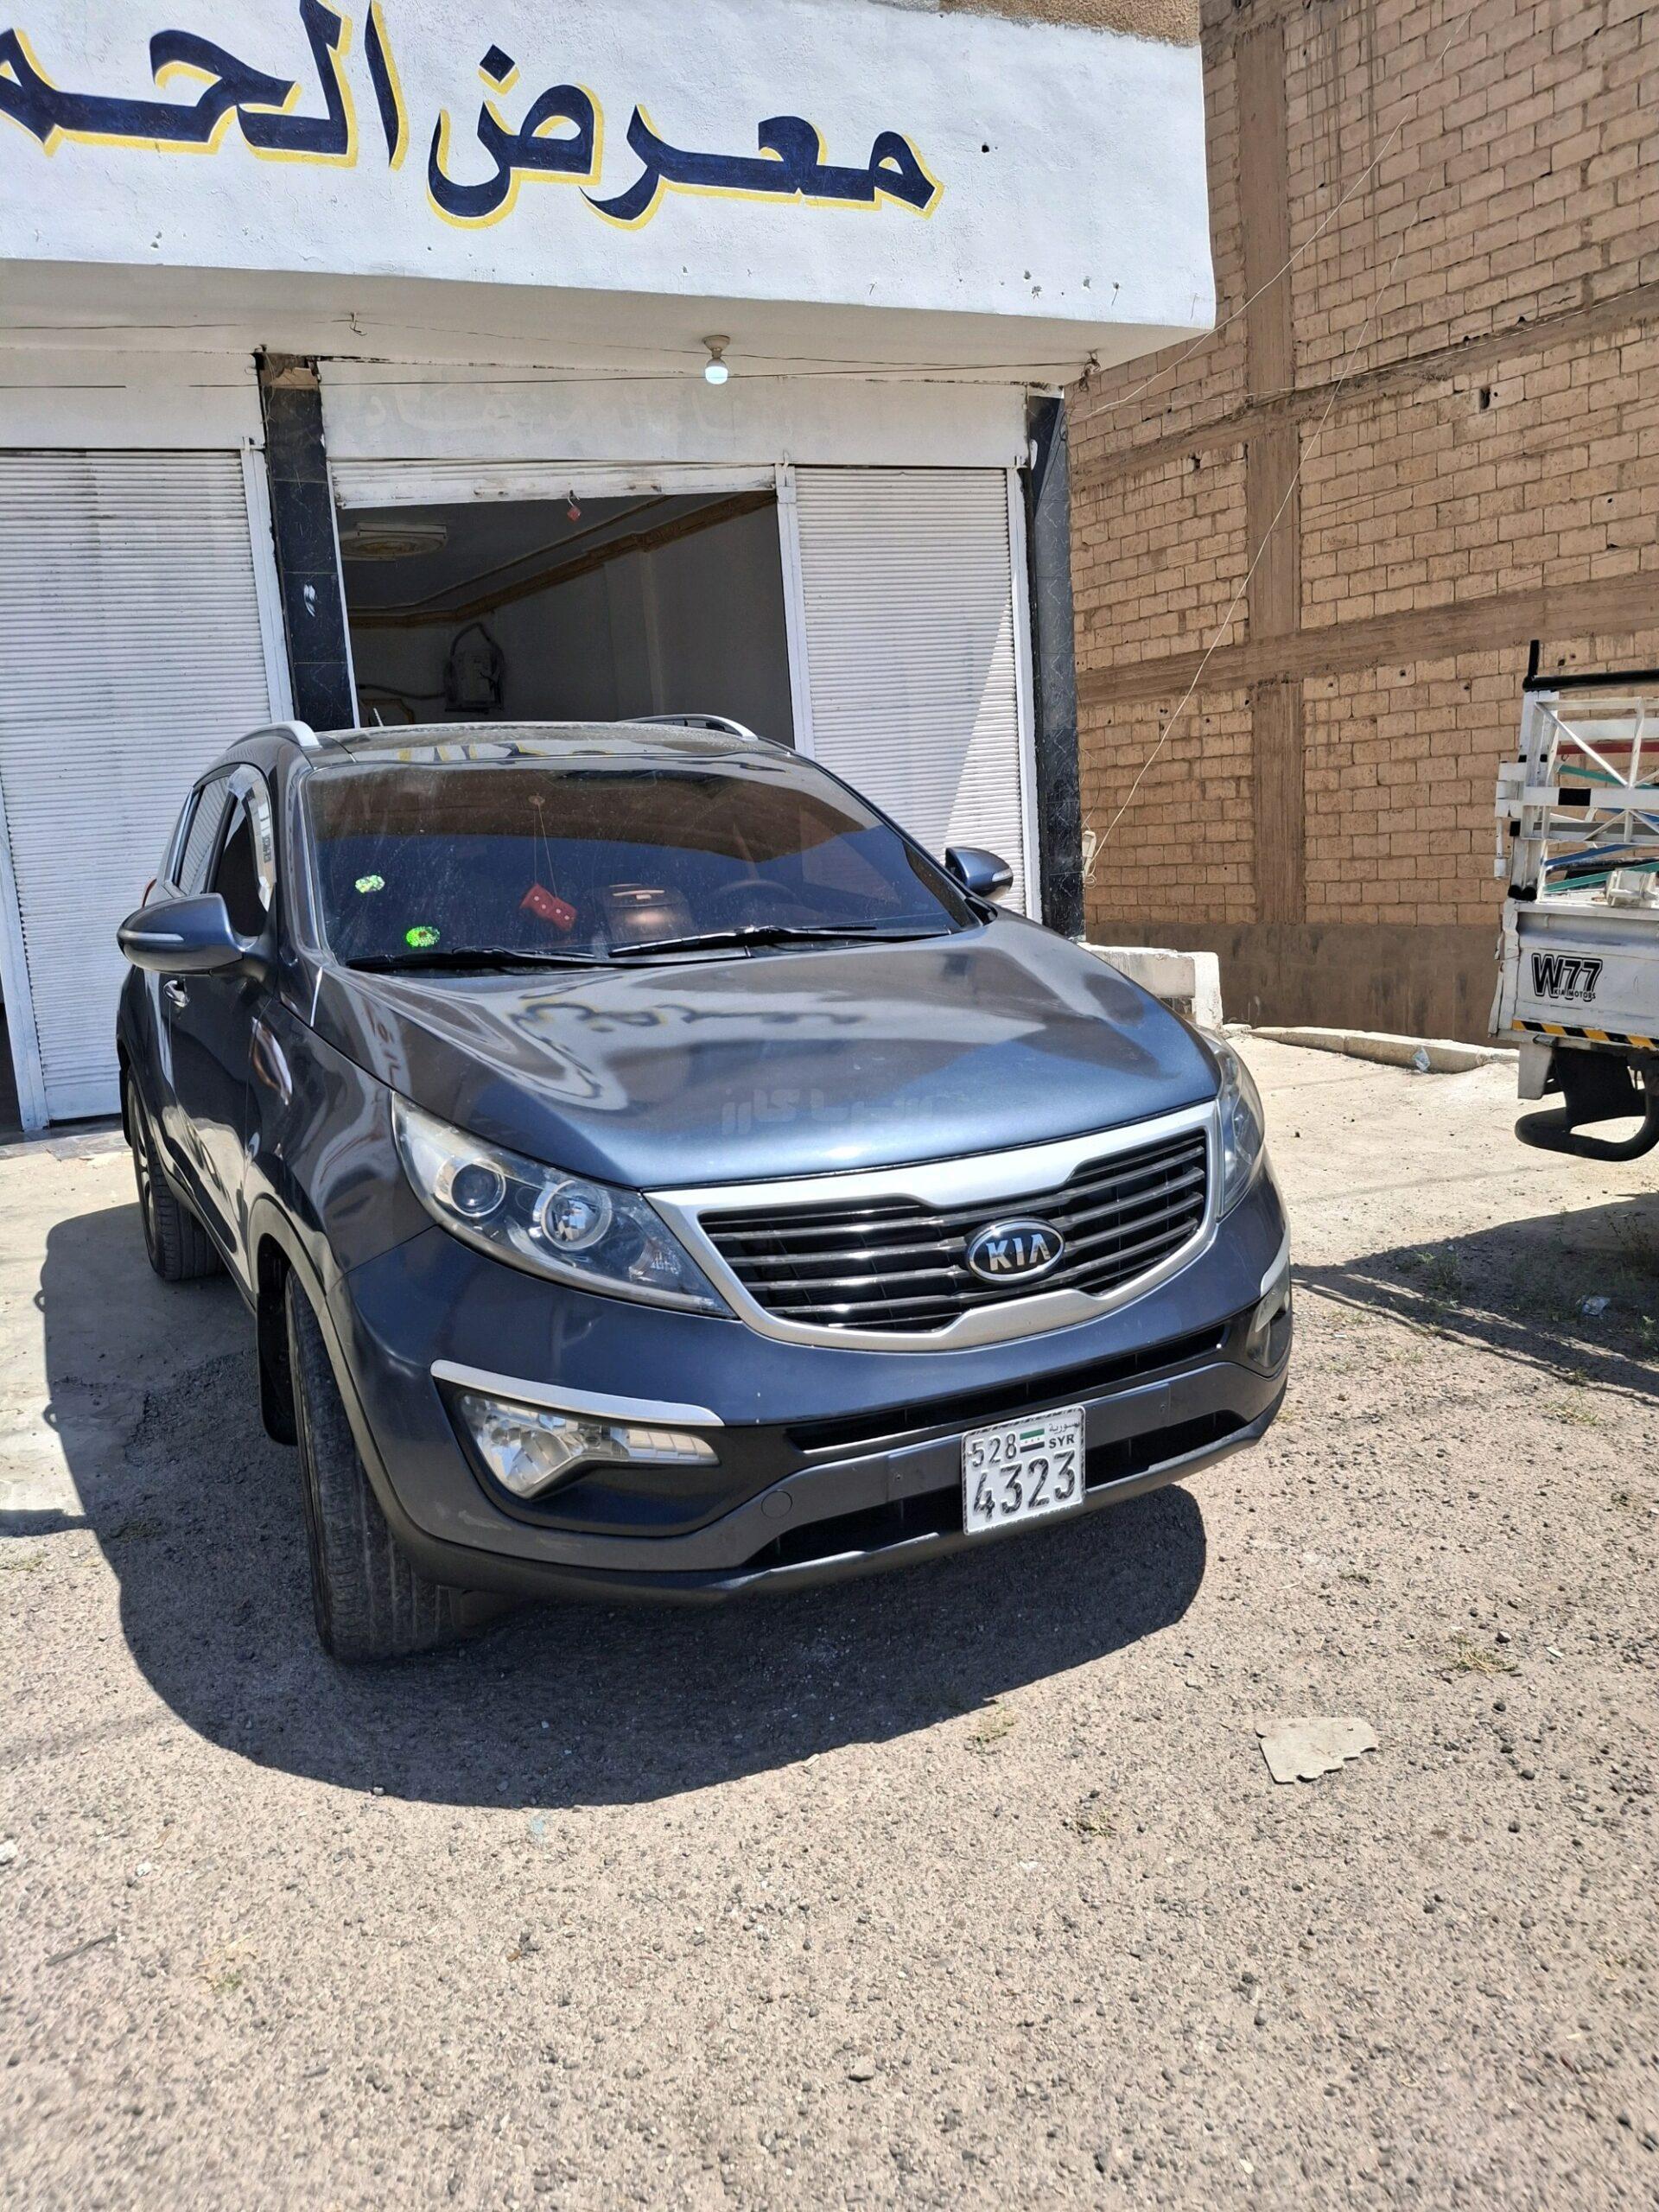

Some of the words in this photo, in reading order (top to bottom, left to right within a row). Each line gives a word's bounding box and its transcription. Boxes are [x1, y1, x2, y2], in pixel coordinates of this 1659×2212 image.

[428, 44, 944, 230] معرض
[1531, 953, 1603, 1001] W77
[986, 1233, 1052, 1271] KIA
[970, 1433, 1018, 1468] 528
[1048, 1433, 1075, 1449] SYR
[973, 1449, 1077, 1522] 4323
